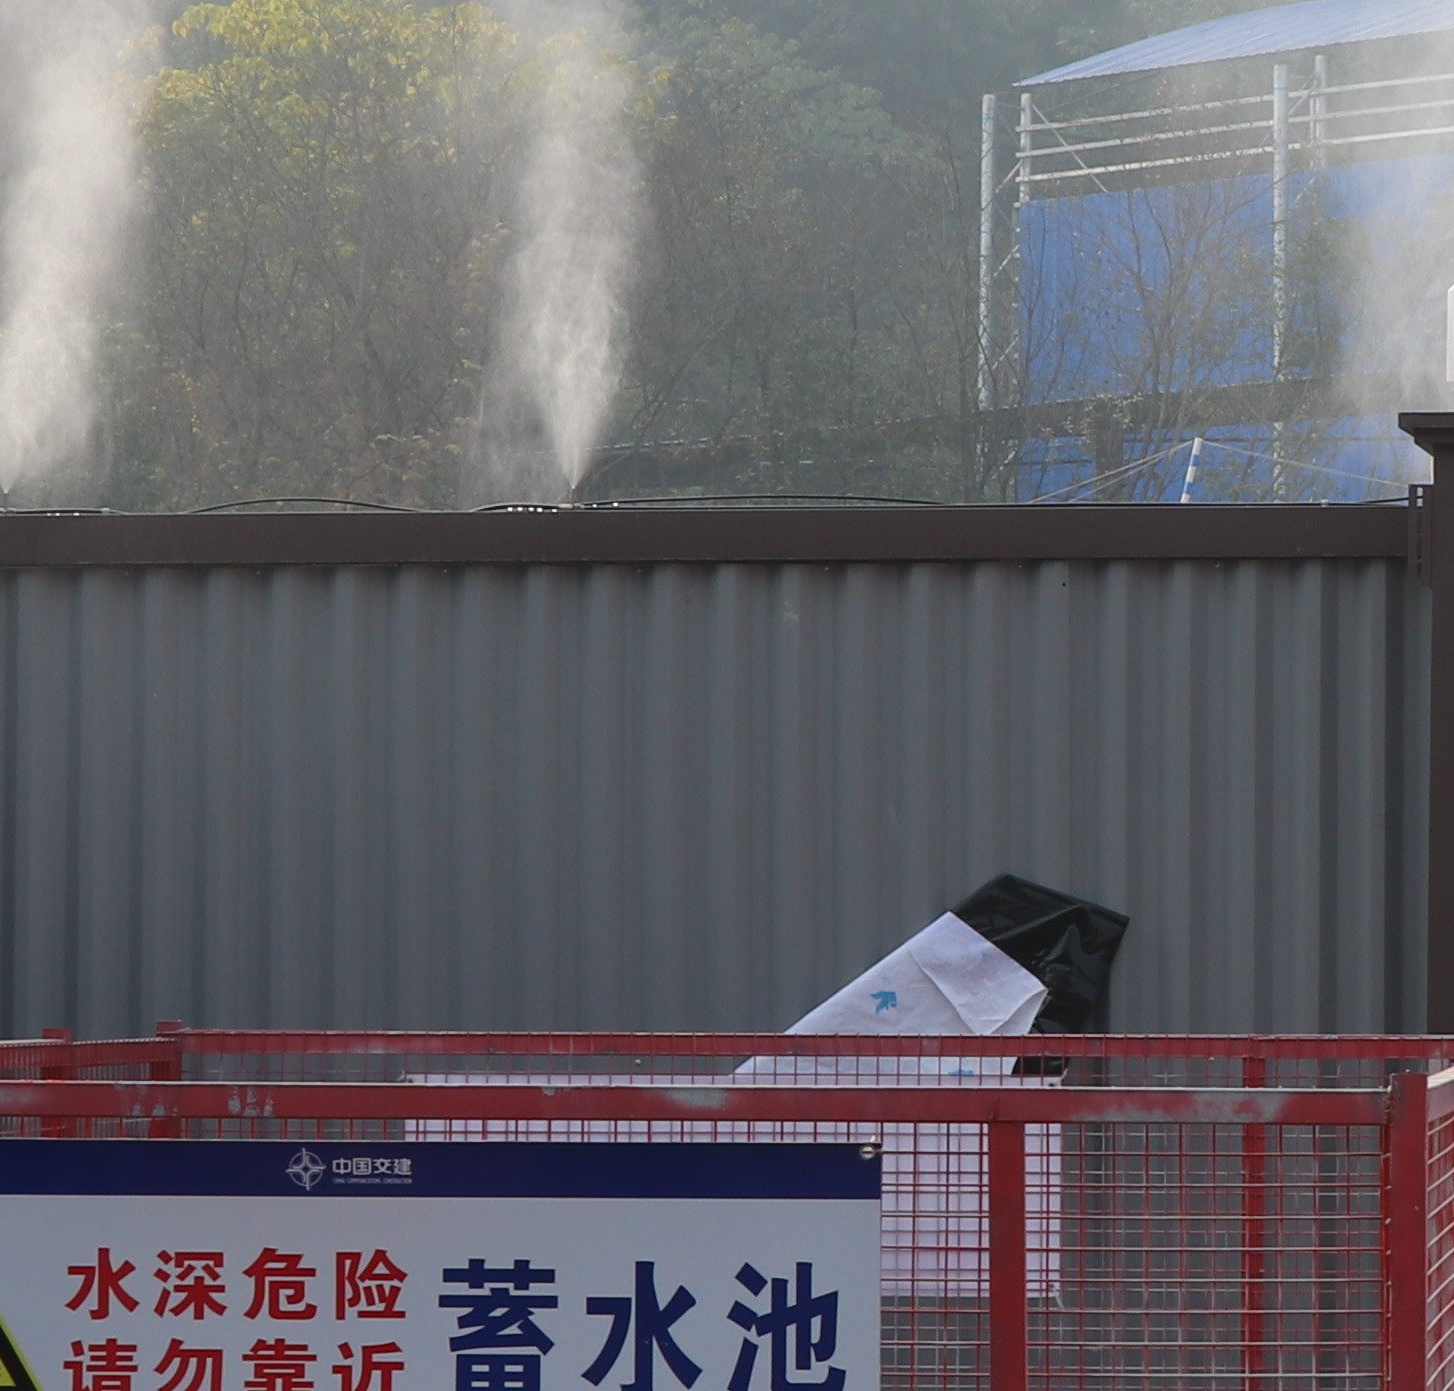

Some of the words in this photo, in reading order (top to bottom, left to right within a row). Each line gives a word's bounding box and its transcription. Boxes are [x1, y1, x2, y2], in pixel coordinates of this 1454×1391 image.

[332, 1158, 412, 1176] 中国交建
[64, 1247, 408, 1321] 水深危险
[438, 1258, 847, 1391] 蓄水池
[63, 1338, 405, 1391] 请勿靠近
